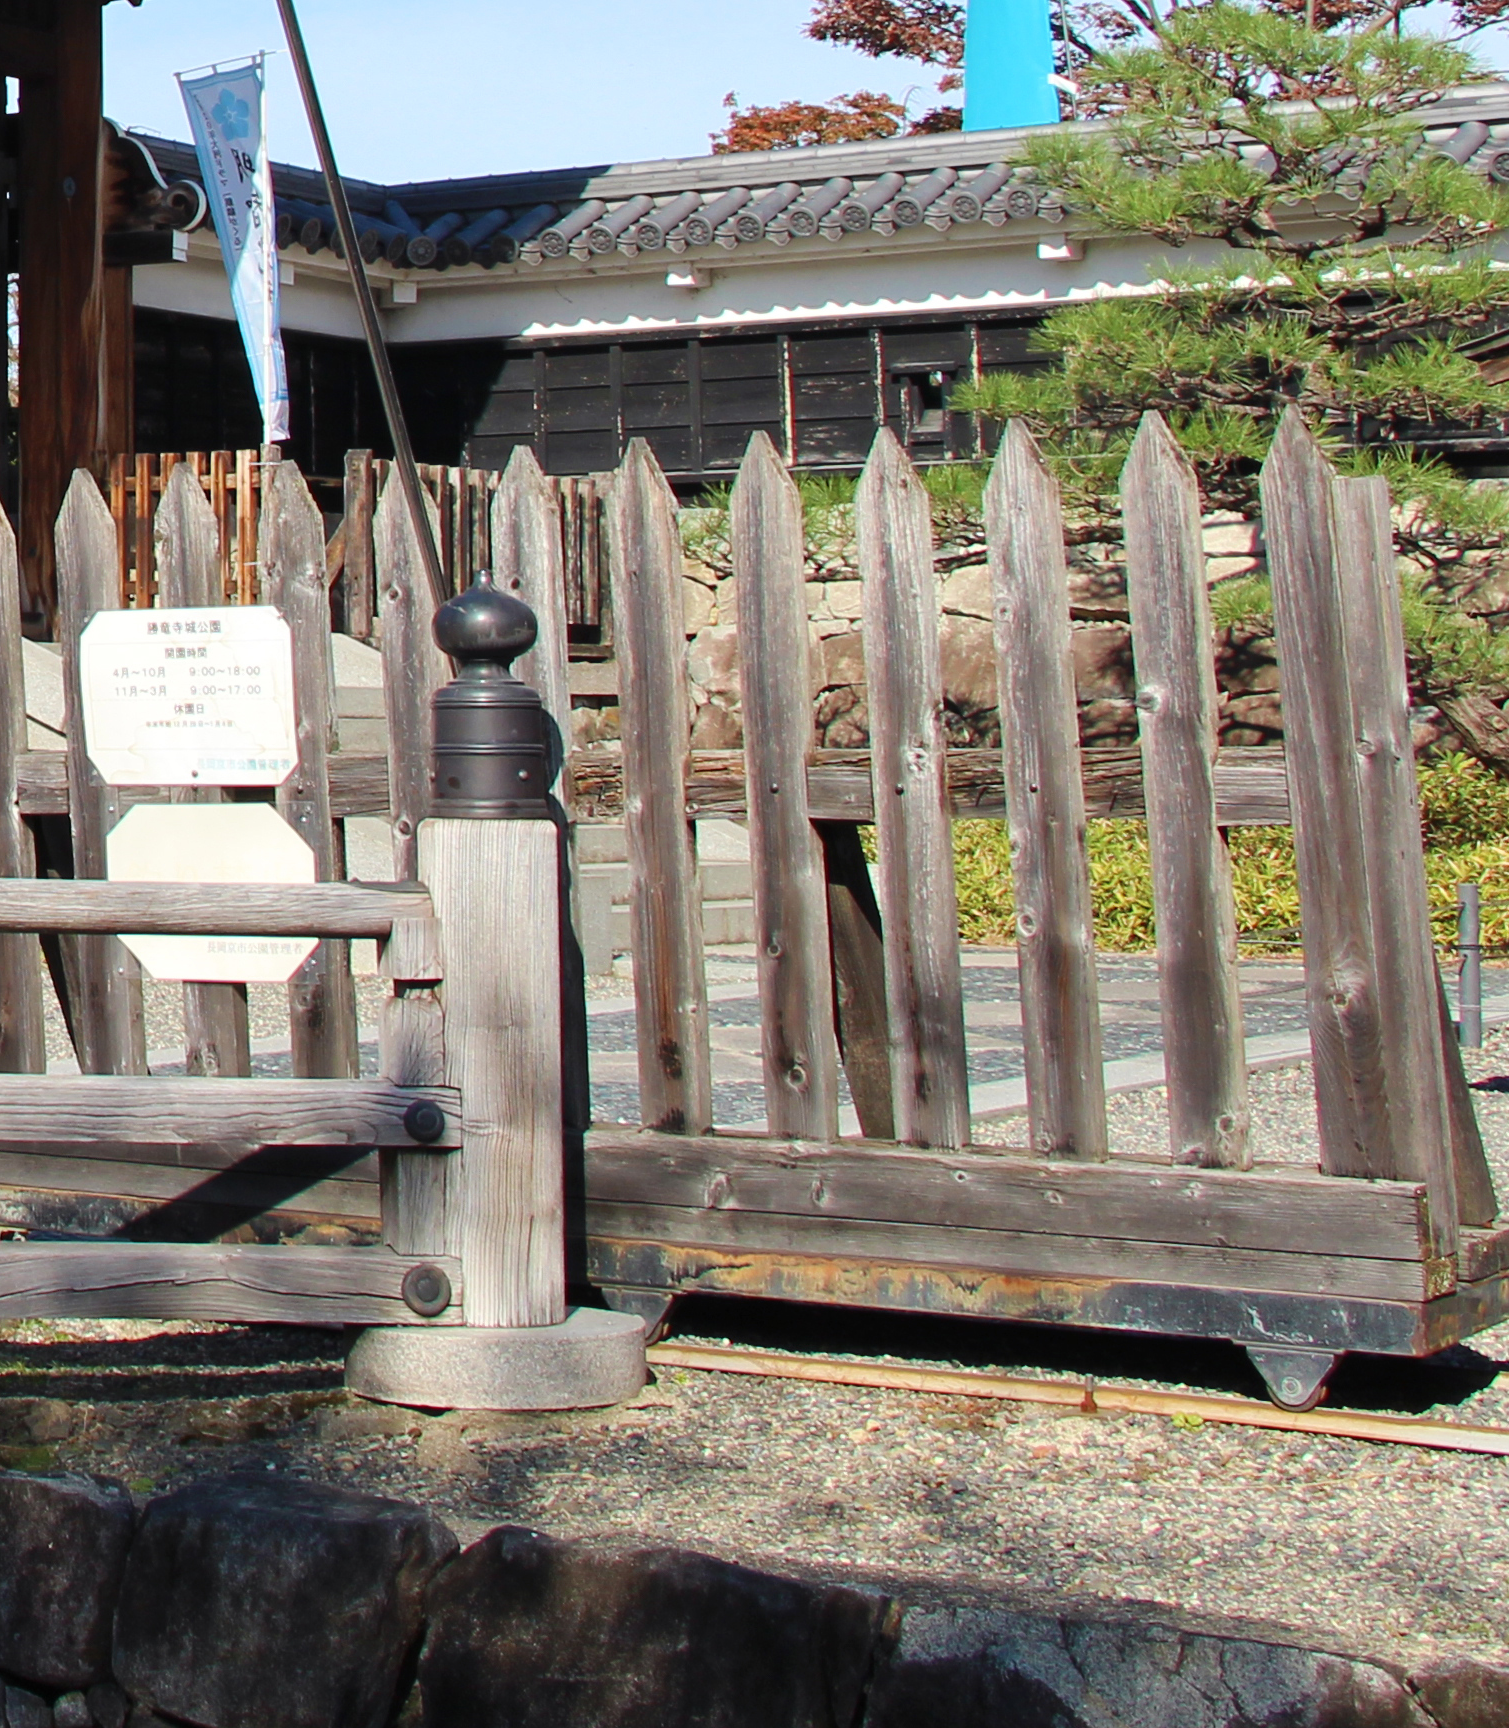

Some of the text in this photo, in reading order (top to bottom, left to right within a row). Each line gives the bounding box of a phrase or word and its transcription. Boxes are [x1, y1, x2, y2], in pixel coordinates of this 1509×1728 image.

[164, 647, 208, 659] 開園時間
[174, 703, 205, 715] 休園日
